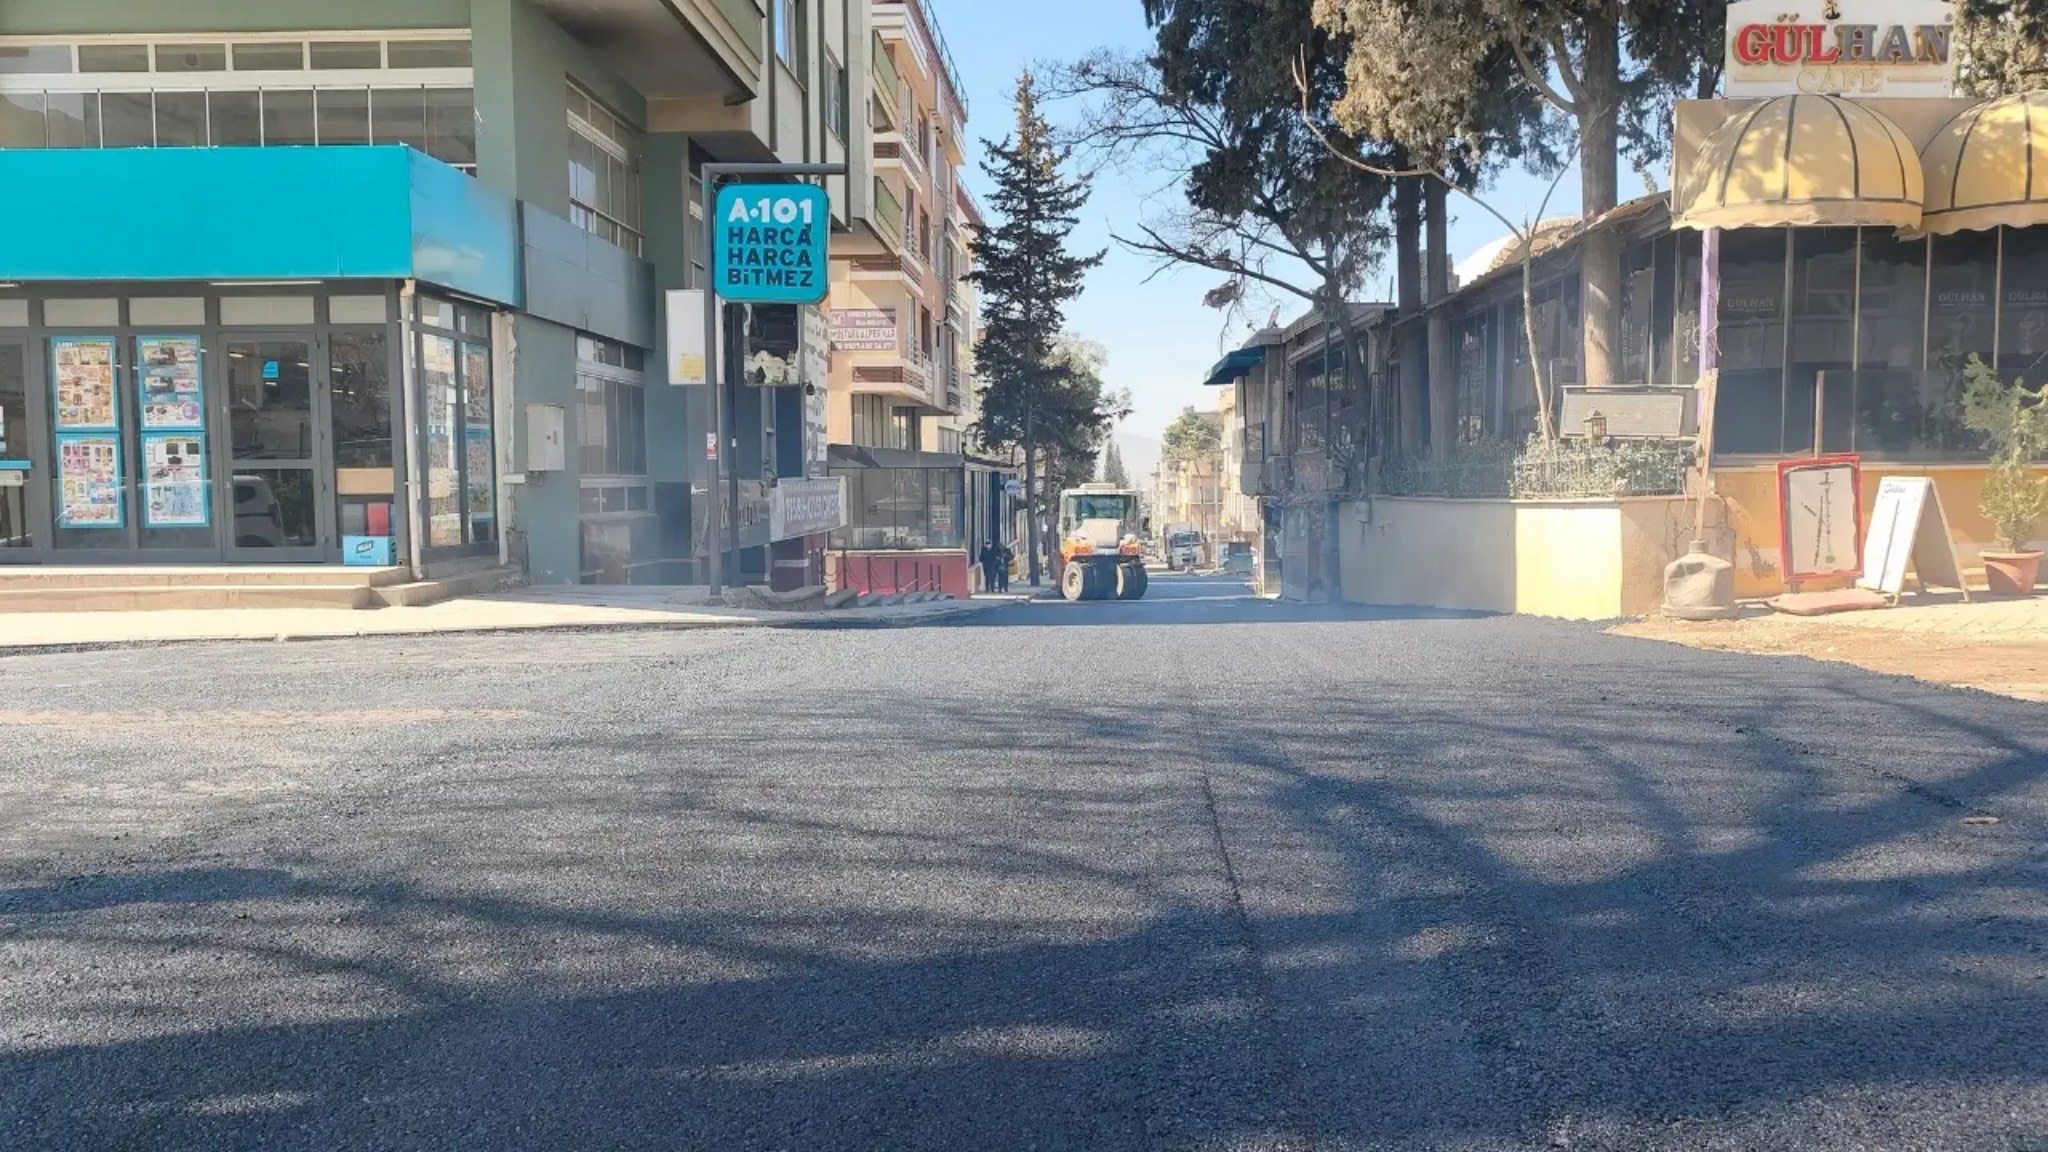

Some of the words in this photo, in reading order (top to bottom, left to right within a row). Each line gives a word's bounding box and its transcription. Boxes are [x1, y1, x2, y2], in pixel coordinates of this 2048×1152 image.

[1735, 12, 1952, 65] GÜLHAN
[1797, 67, 1881, 92] CAFE
[727, 226, 812, 246] HARCA
[727, 247, 812, 267] HARCA
